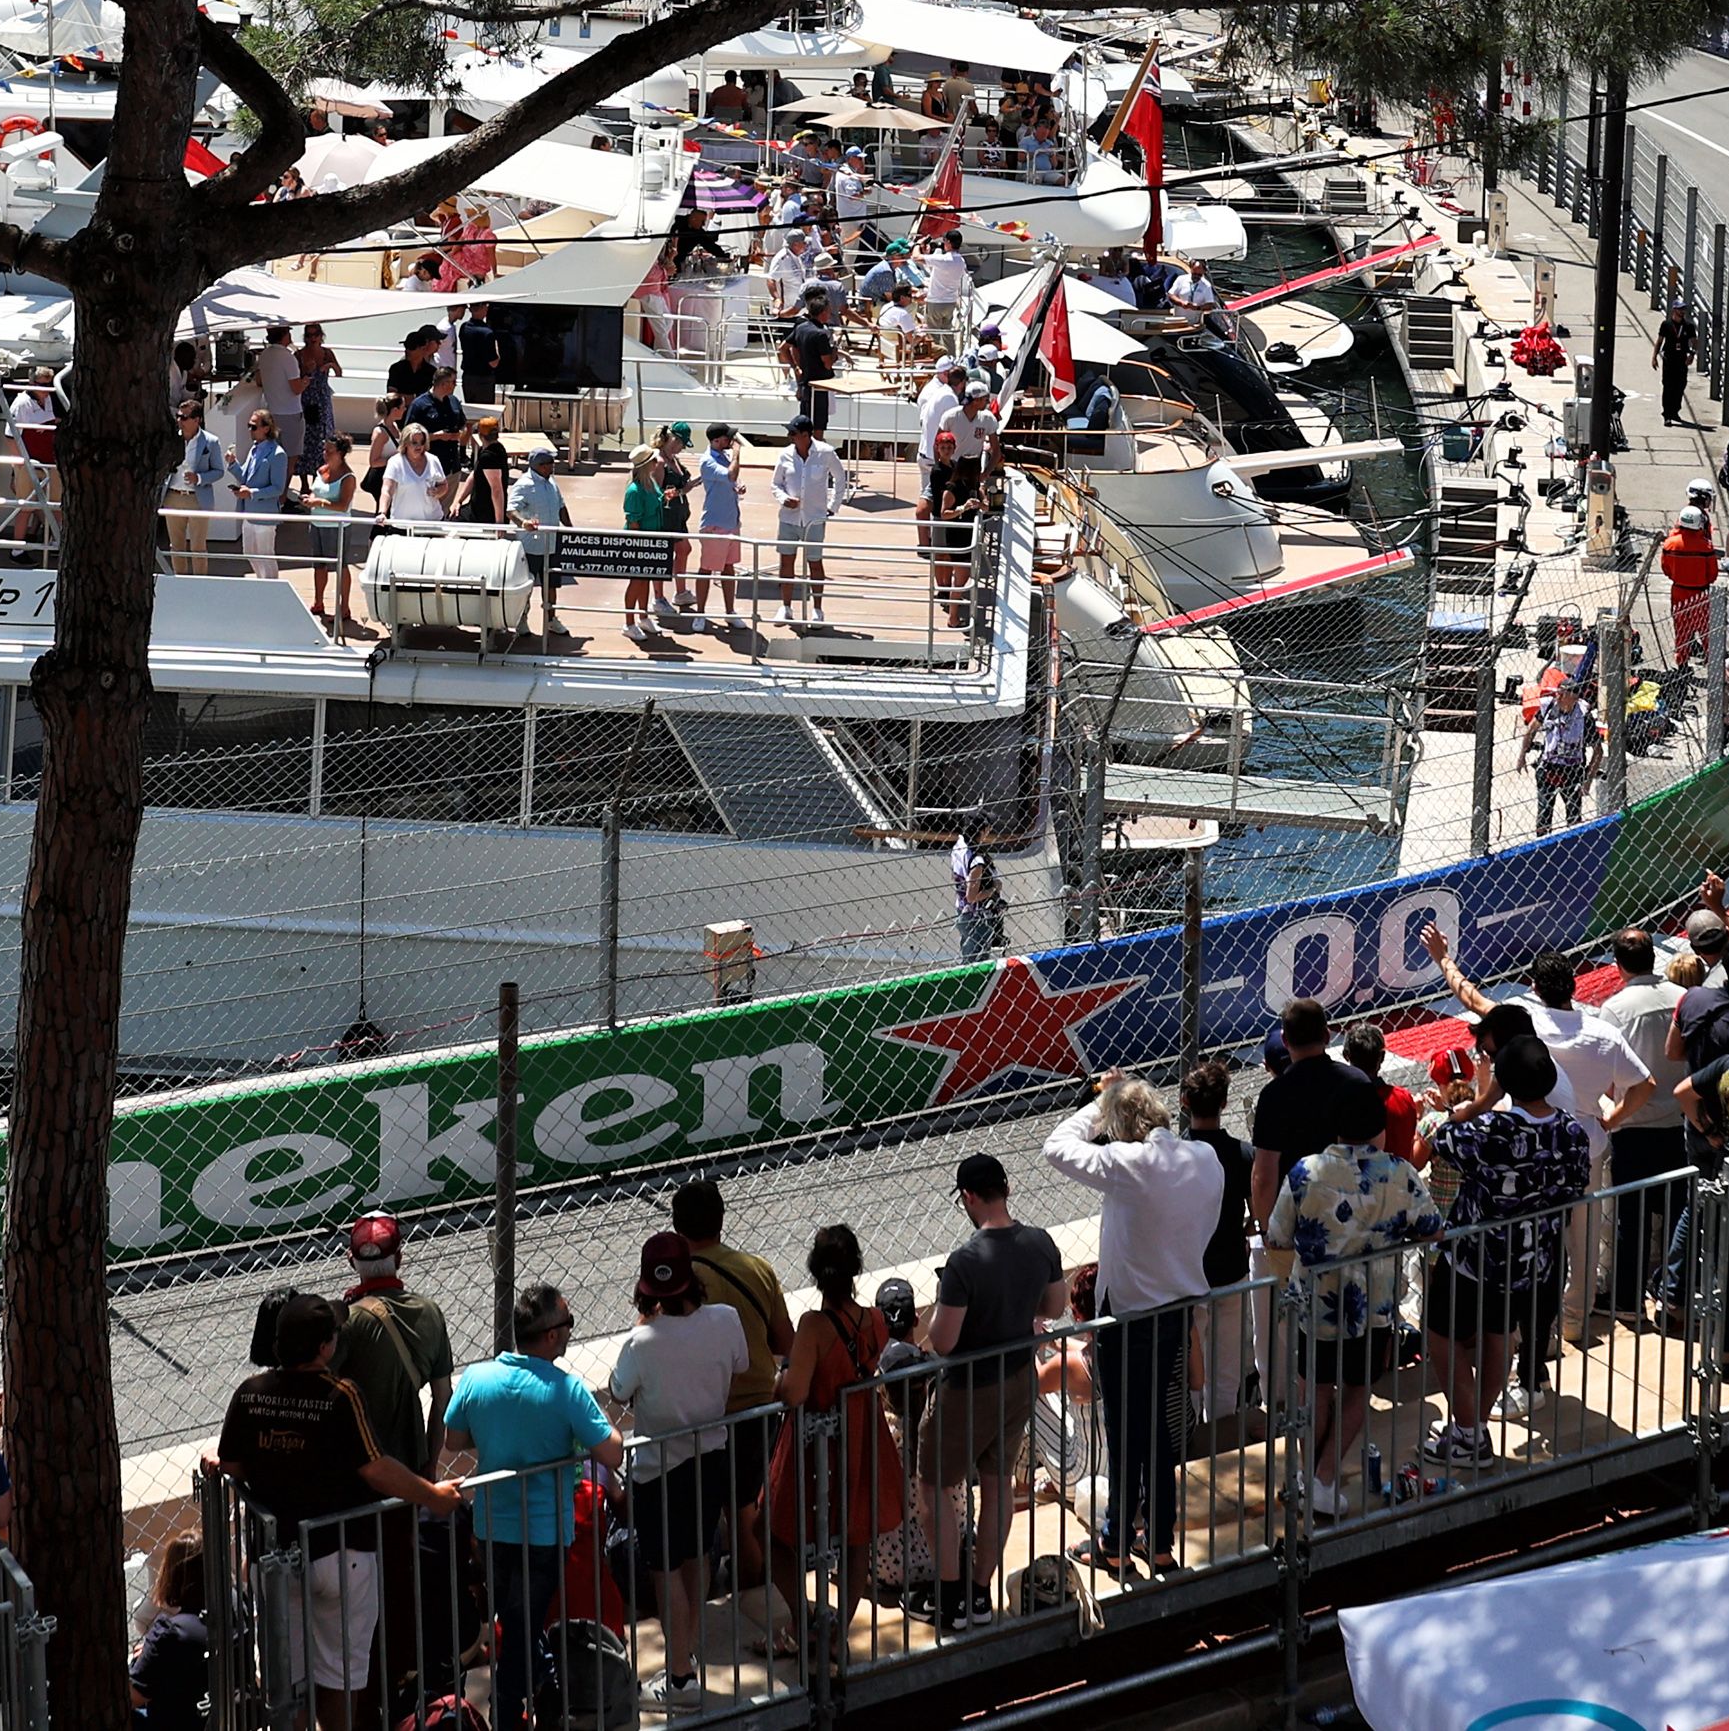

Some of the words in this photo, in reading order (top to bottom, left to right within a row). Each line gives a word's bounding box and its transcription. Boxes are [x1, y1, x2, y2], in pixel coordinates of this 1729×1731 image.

[561, 534, 601, 545] PLACES
[602, 537, 669, 549] DISPONIBLES
[561, 548, 621, 559] AVAILABILITY
[622, 551, 636, 559] ON
[637, 552, 668, 561] BOARD
[560, 562, 577, 570] TEL
[579, 563, 601, 571] +377
[616, 565, 628, 573] 07
[655, 567, 668, 575] 87
[33, 580, 57, 618] 1
[240, 1393, 256, 1403] THE
